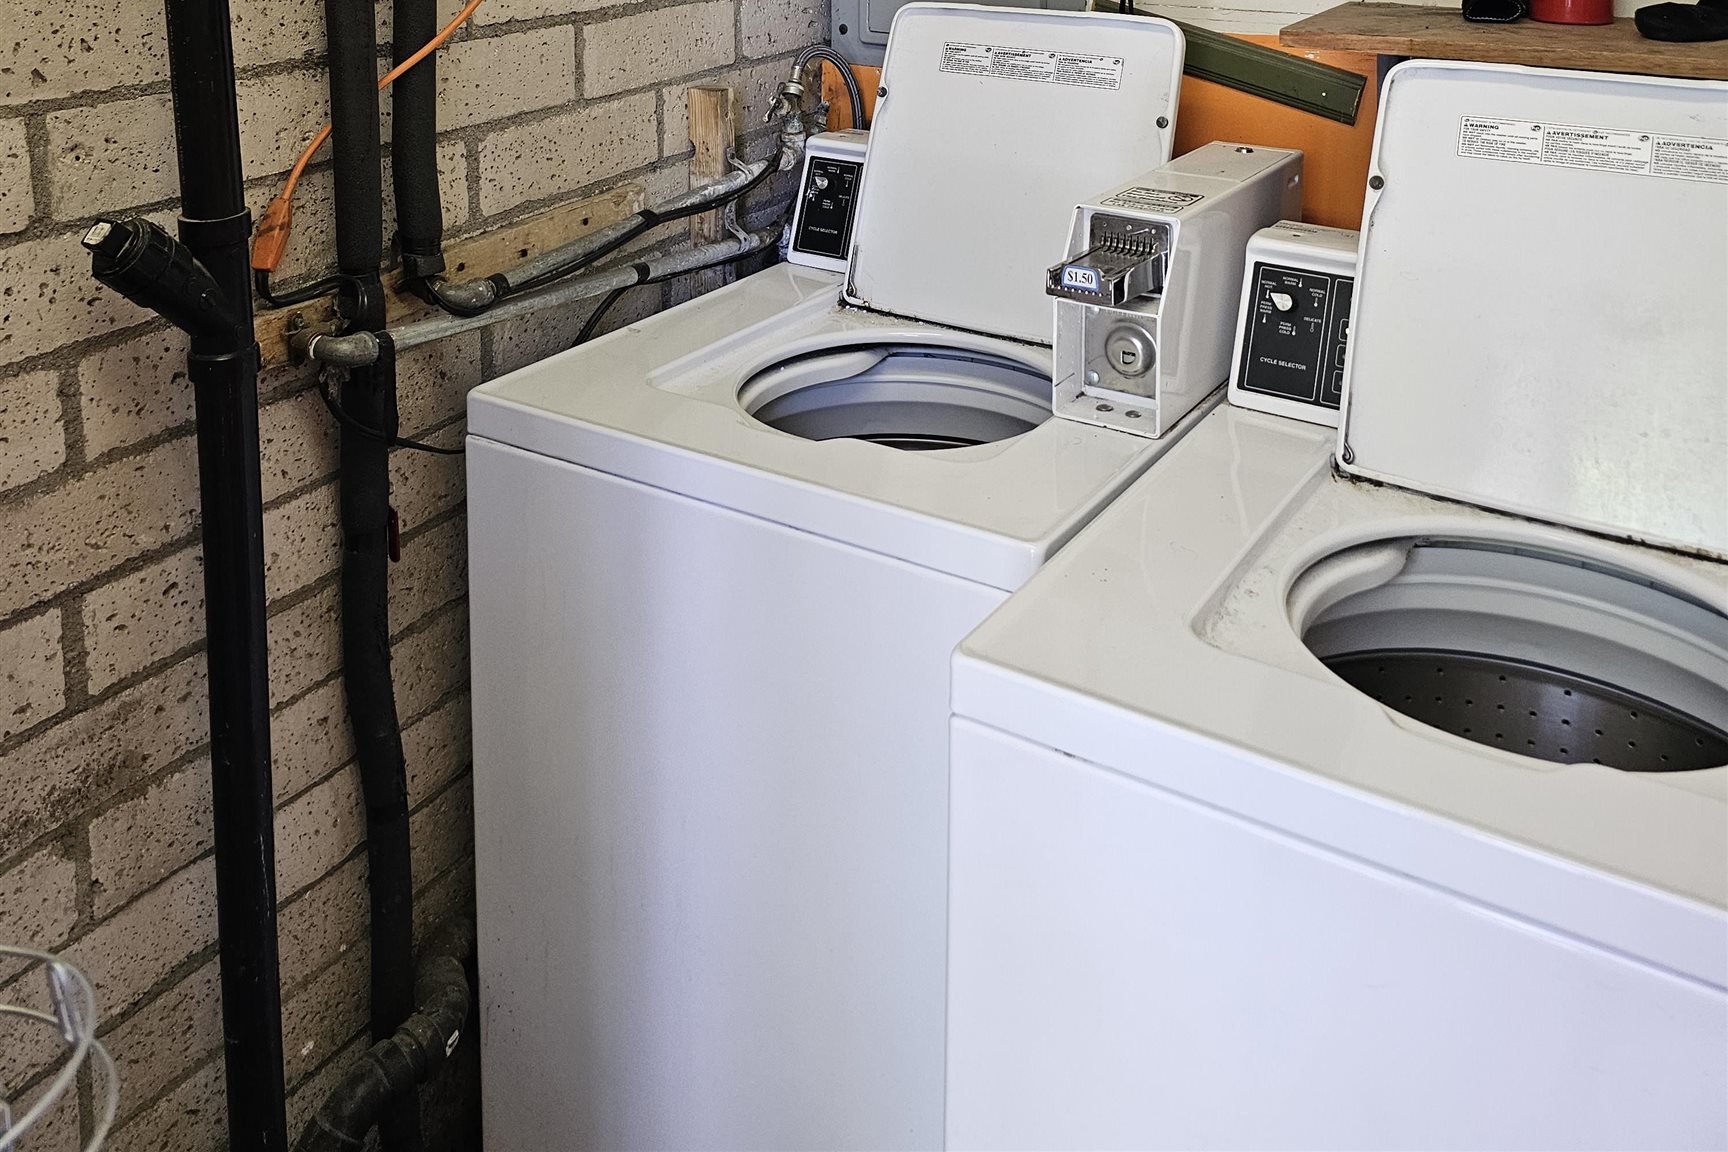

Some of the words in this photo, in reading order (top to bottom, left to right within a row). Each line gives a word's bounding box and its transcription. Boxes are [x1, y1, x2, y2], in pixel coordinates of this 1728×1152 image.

[1552, 131, 1608, 140] AVERTISSEMENT
[1662, 141, 1713, 150] ADVERTENCIA
[1068, 271, 1093, 284] $1.50
[1260, 356, 1277, 364] CYCLE
[1278, 360, 1306, 370] SELECTOR
